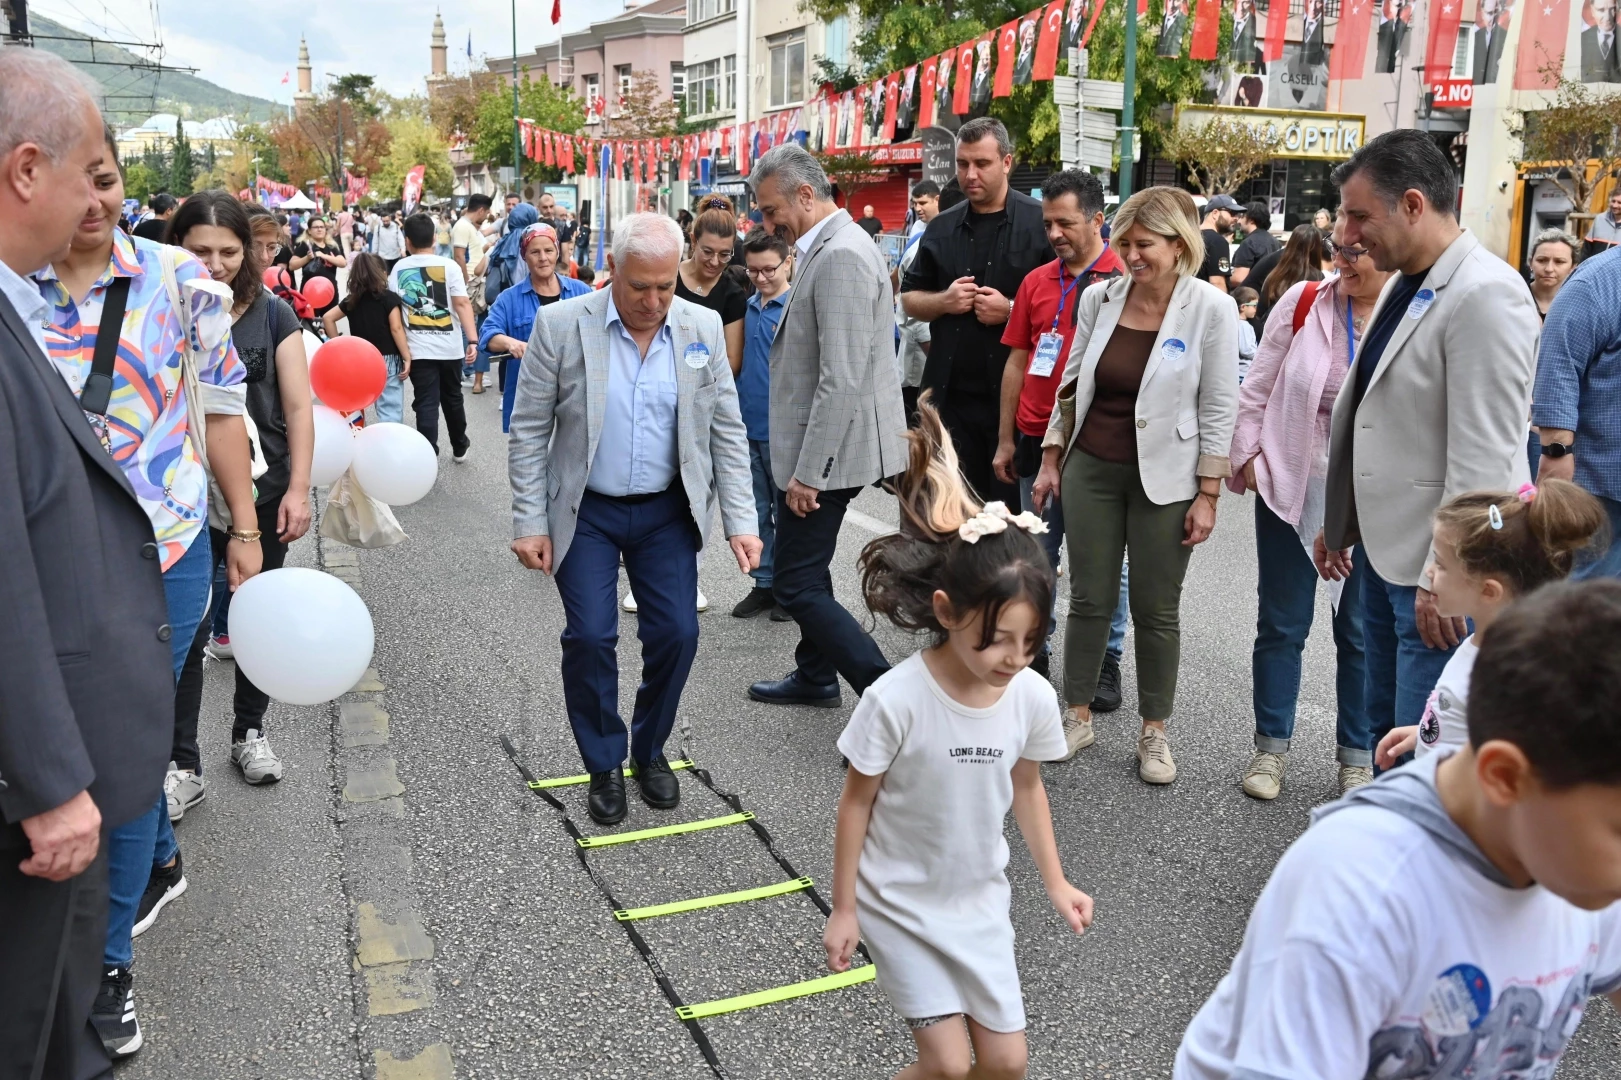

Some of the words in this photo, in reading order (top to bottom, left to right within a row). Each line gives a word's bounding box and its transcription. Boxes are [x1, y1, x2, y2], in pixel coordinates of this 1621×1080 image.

[1280, 72, 1318, 86] CASELLI
[949, 747, 974, 757] LONG
[975, 747, 1004, 759] BEACH
